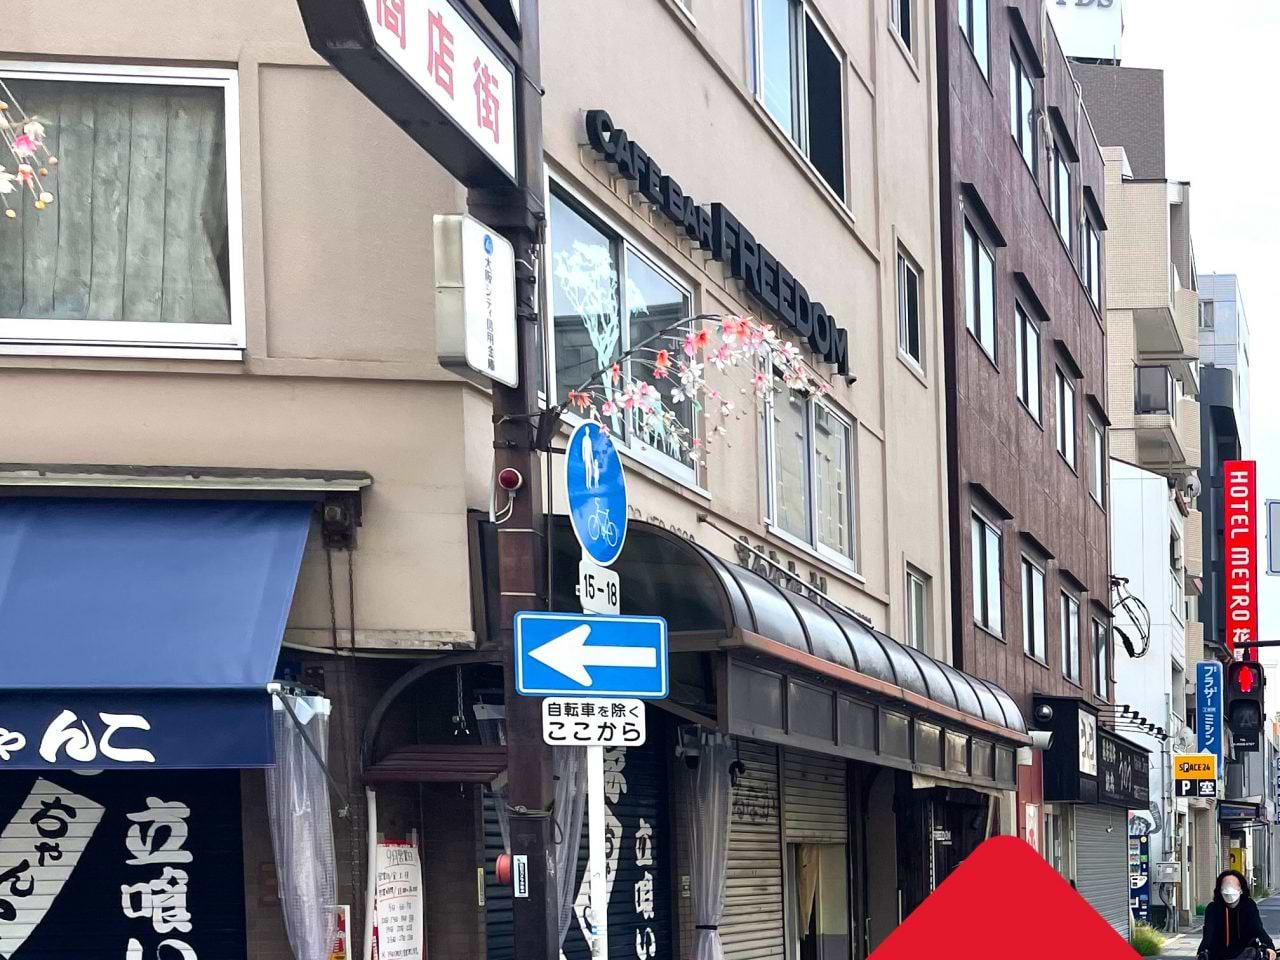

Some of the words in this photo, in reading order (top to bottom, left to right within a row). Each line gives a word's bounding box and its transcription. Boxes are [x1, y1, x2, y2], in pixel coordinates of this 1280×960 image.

[585, 108, 662, 210] CAFE
[660, 174, 714, 252] BAR
[710, 201, 850, 377] FREEDOM
[484, 257, 496, 372] 大阪シティ信用金庫
[1229, 470, 1249, 540] HOTEL
[583, 573, 618, 607] 15-18
[1230, 547, 1251, 622] METRO
[1203, 665, 1218, 706] ブラザー
[547, 701, 640, 719] 自転車を除く
[547, 721, 641, 742] ここから
[1203, 713, 1216, 746] ミシン
[1202, 763, 1211, 772] 24
[1181, 780, 1191, 796] P
[1199, 781, 1216, 795] 空
